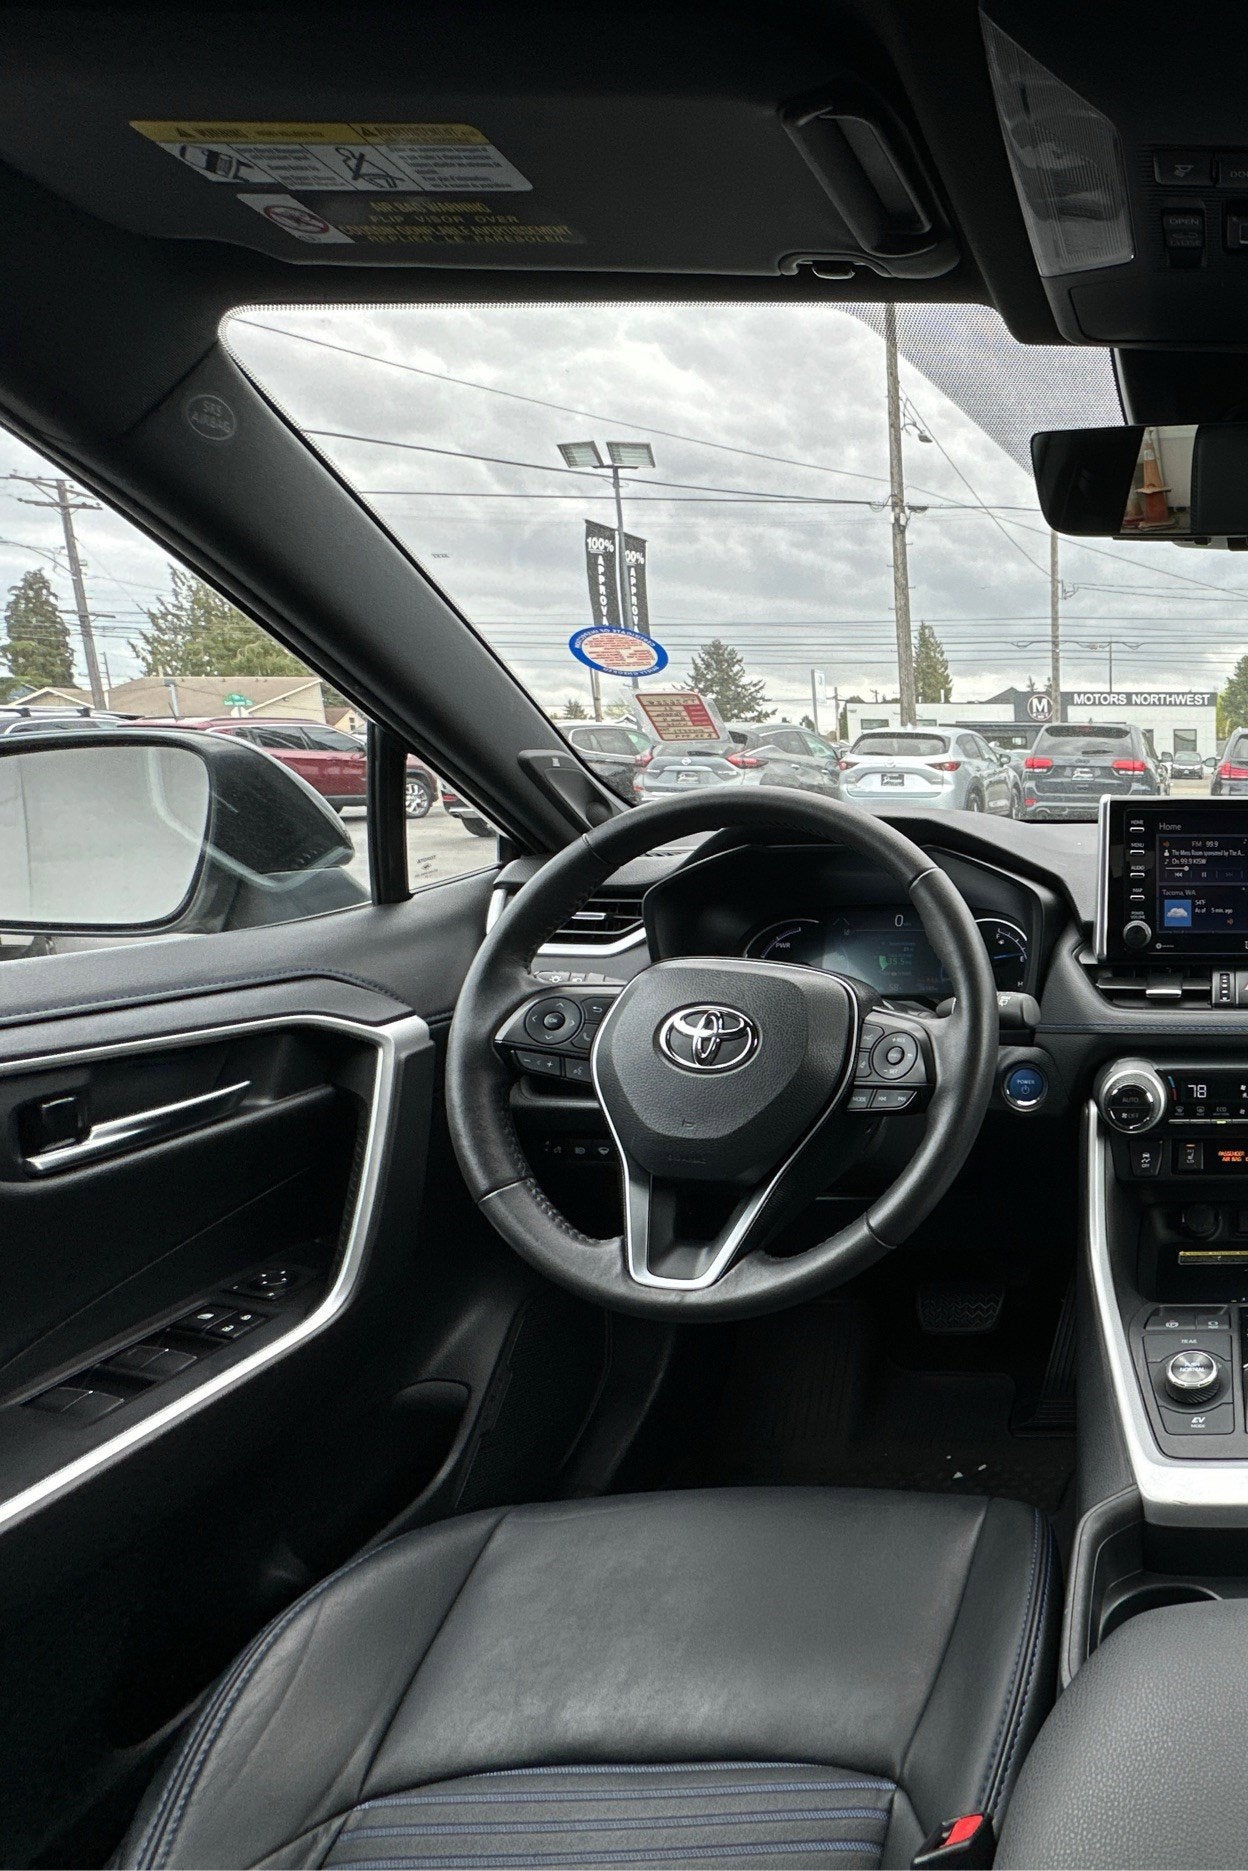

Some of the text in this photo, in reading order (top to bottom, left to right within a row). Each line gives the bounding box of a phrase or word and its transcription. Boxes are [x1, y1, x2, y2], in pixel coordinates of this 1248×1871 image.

[414, 215, 466, 223] VISOR
[474, 215, 519, 223] OVER
[587, 537, 614, 552] 100%
[1073, 693, 1210, 706] MOTORS NORTHWEST
[1159, 822, 1182, 831] Home
[894, 914, 904, 927] 0
[1188, 1085, 1207, 1098] 78
